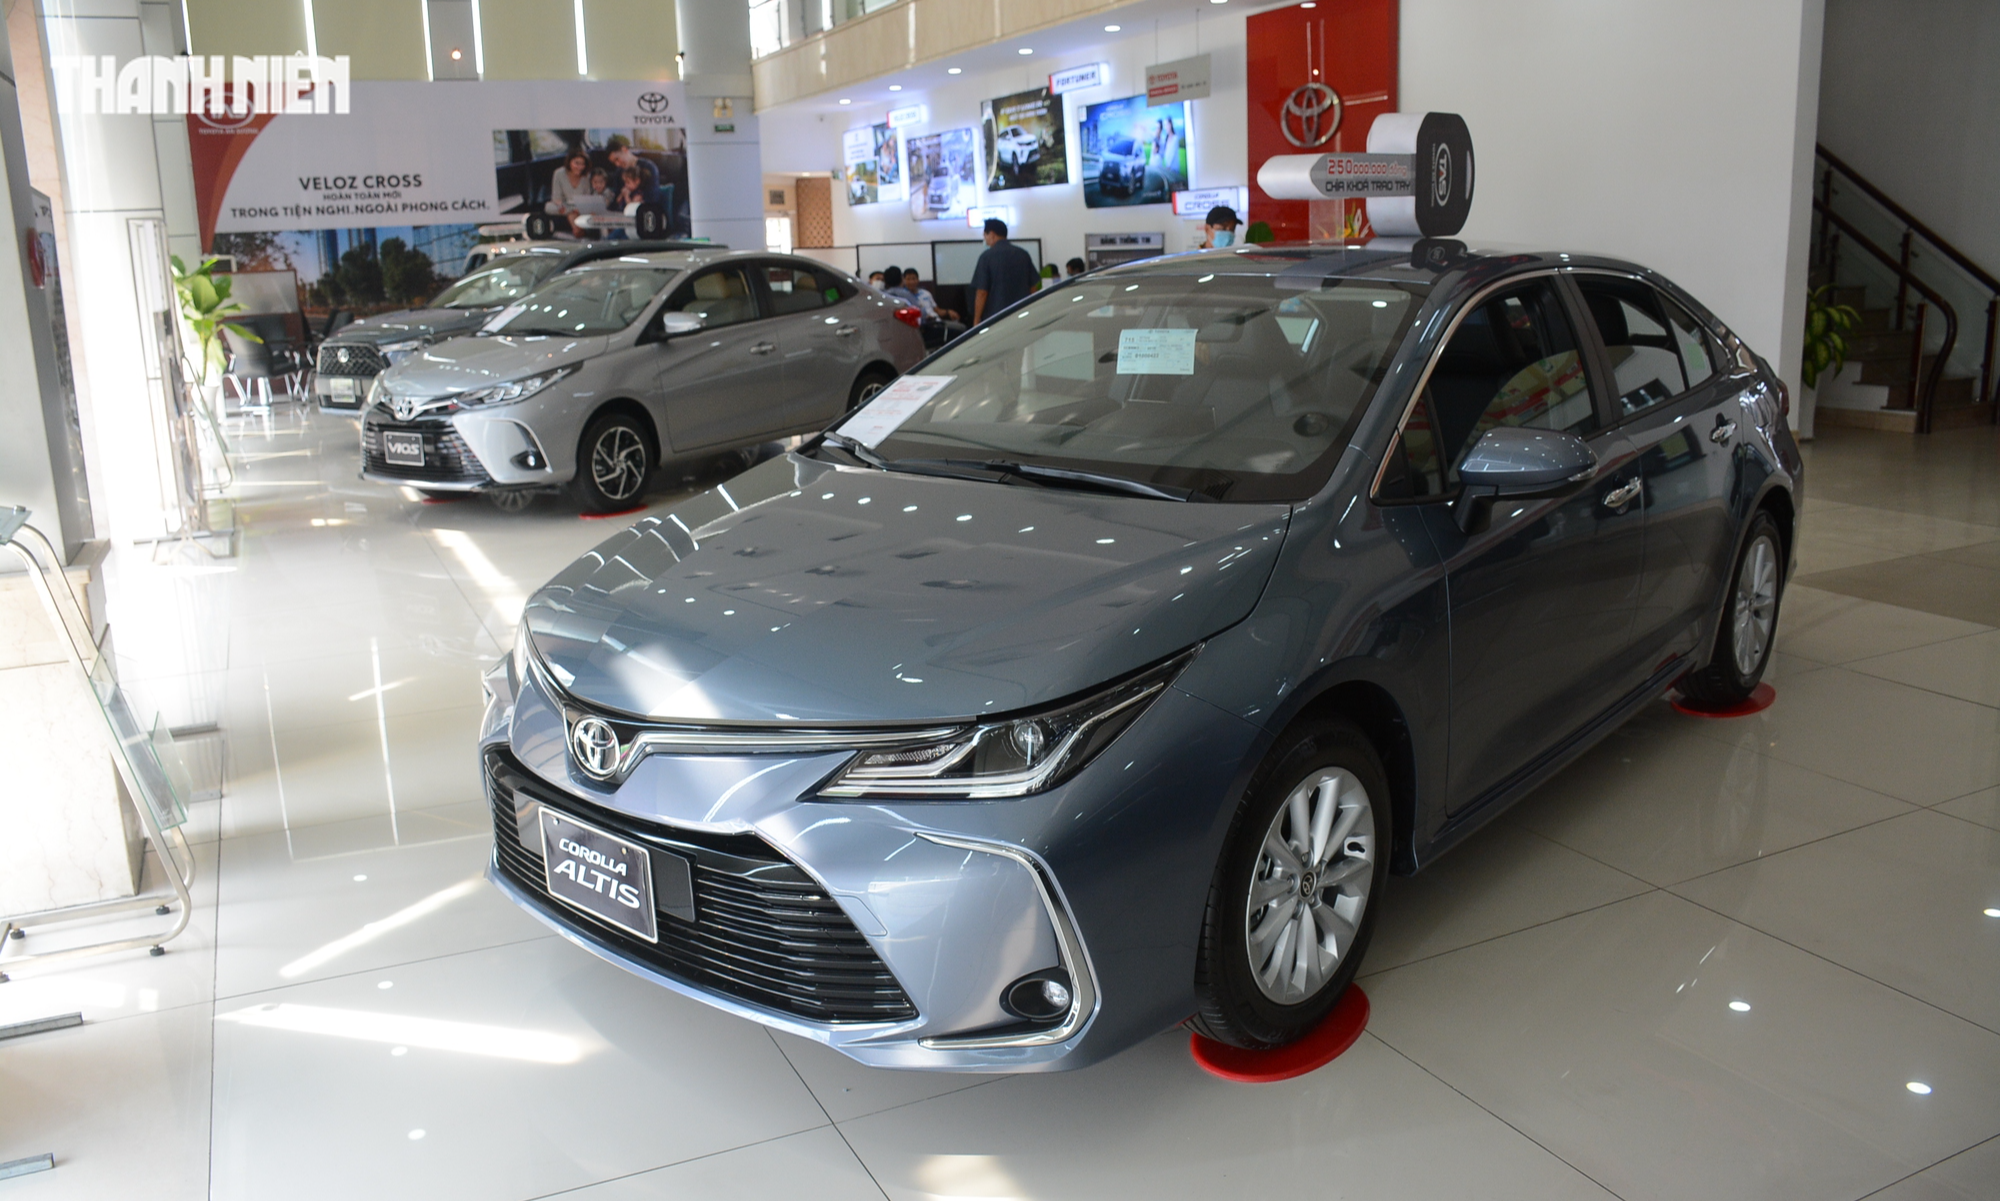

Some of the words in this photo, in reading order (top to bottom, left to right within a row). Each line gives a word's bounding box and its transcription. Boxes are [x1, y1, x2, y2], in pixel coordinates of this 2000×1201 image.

[633, 115, 675, 124] TOYOTA
[298, 176, 358, 190] VELOZ
[363, 174, 422, 189] CROSS
[1370, 181, 1393, 191] TRAO
[1394, 180, 1410, 191] TAY
[323, 191, 351, 201] HOÀN
[354, 190, 378, 200] TOÀN
[231, 207, 279, 218] TRONG
[282, 204, 312, 220] TIỆN
[402, 201, 448, 212] PHONG
[387, 441, 420, 455] VIOS
[559, 838, 627, 877] COROLLA
[553, 859, 640, 909] ALTIS
